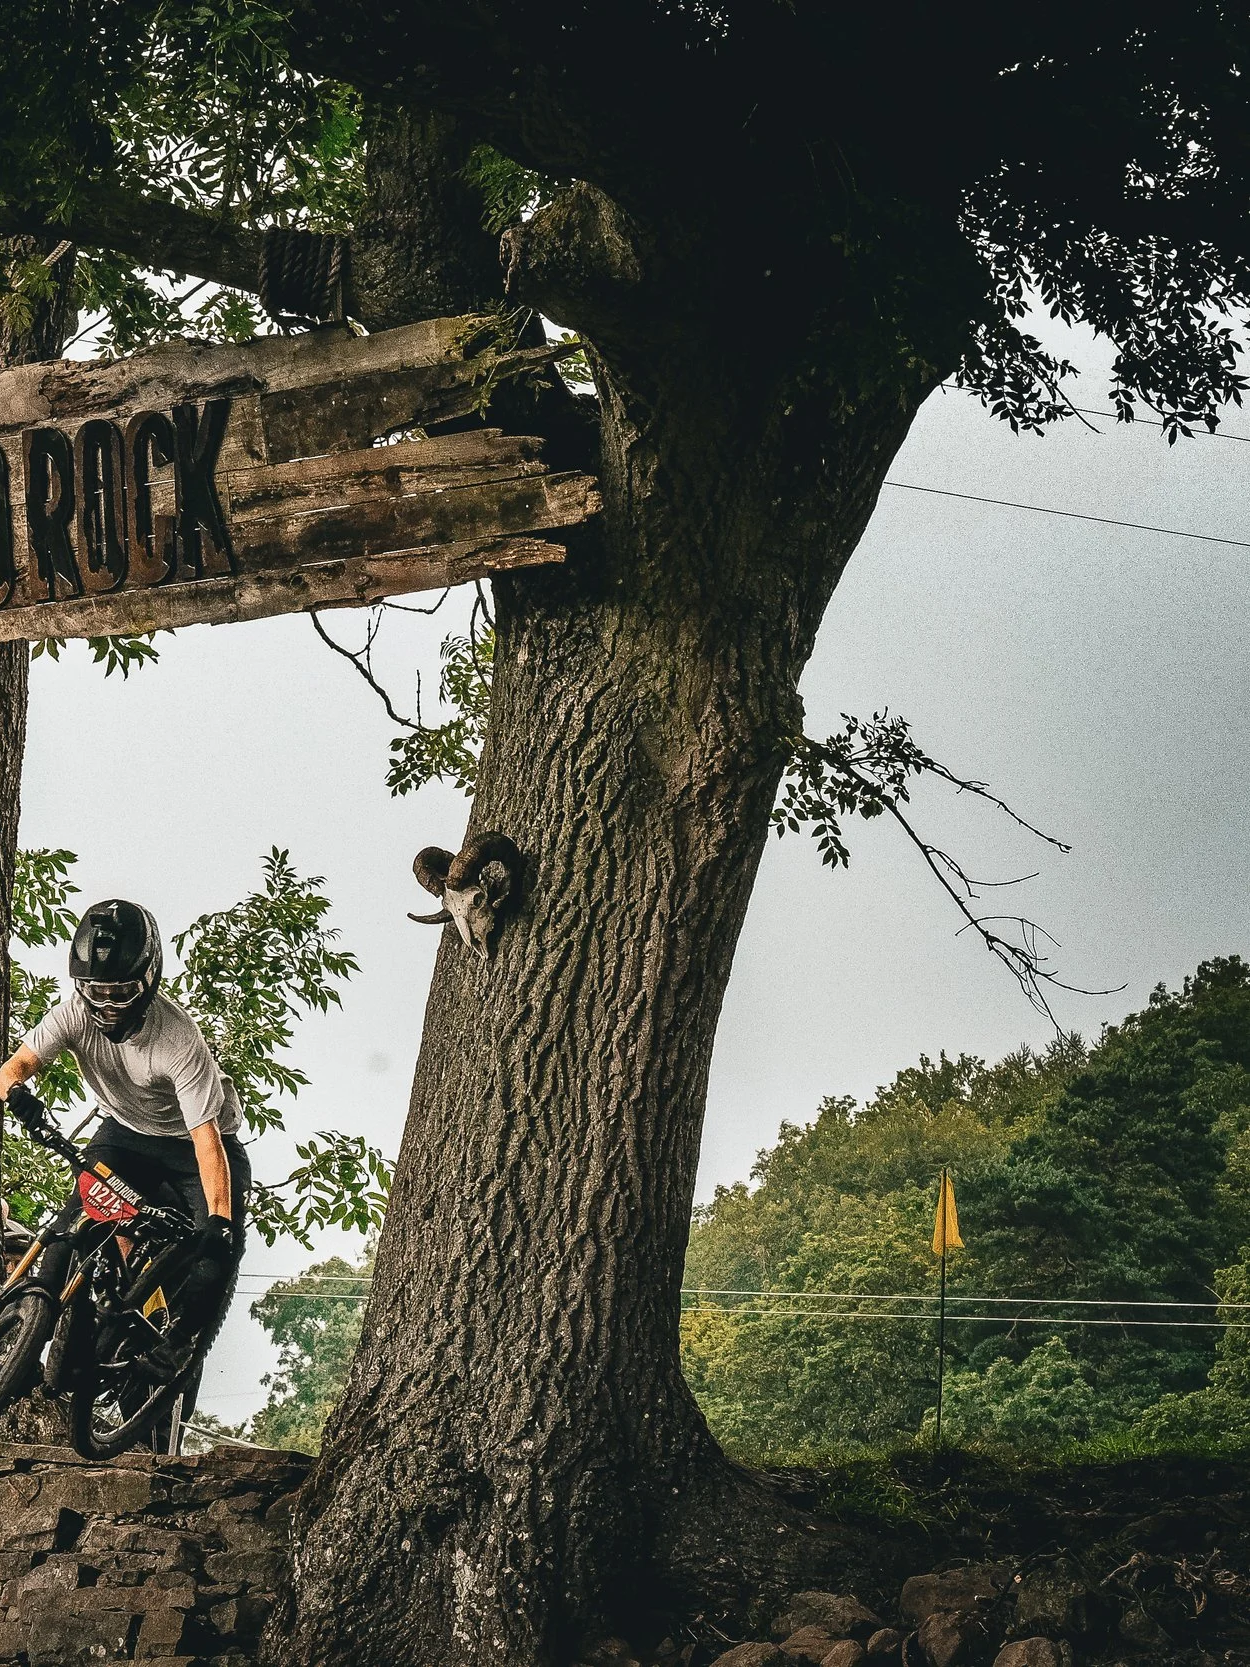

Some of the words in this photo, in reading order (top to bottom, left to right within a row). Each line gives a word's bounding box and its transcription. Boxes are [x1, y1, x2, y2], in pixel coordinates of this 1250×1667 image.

[22, 399, 239, 605] ROCK
[106, 1175, 125, 1192] ARD
[118, 1186, 142, 1206] ROCK
